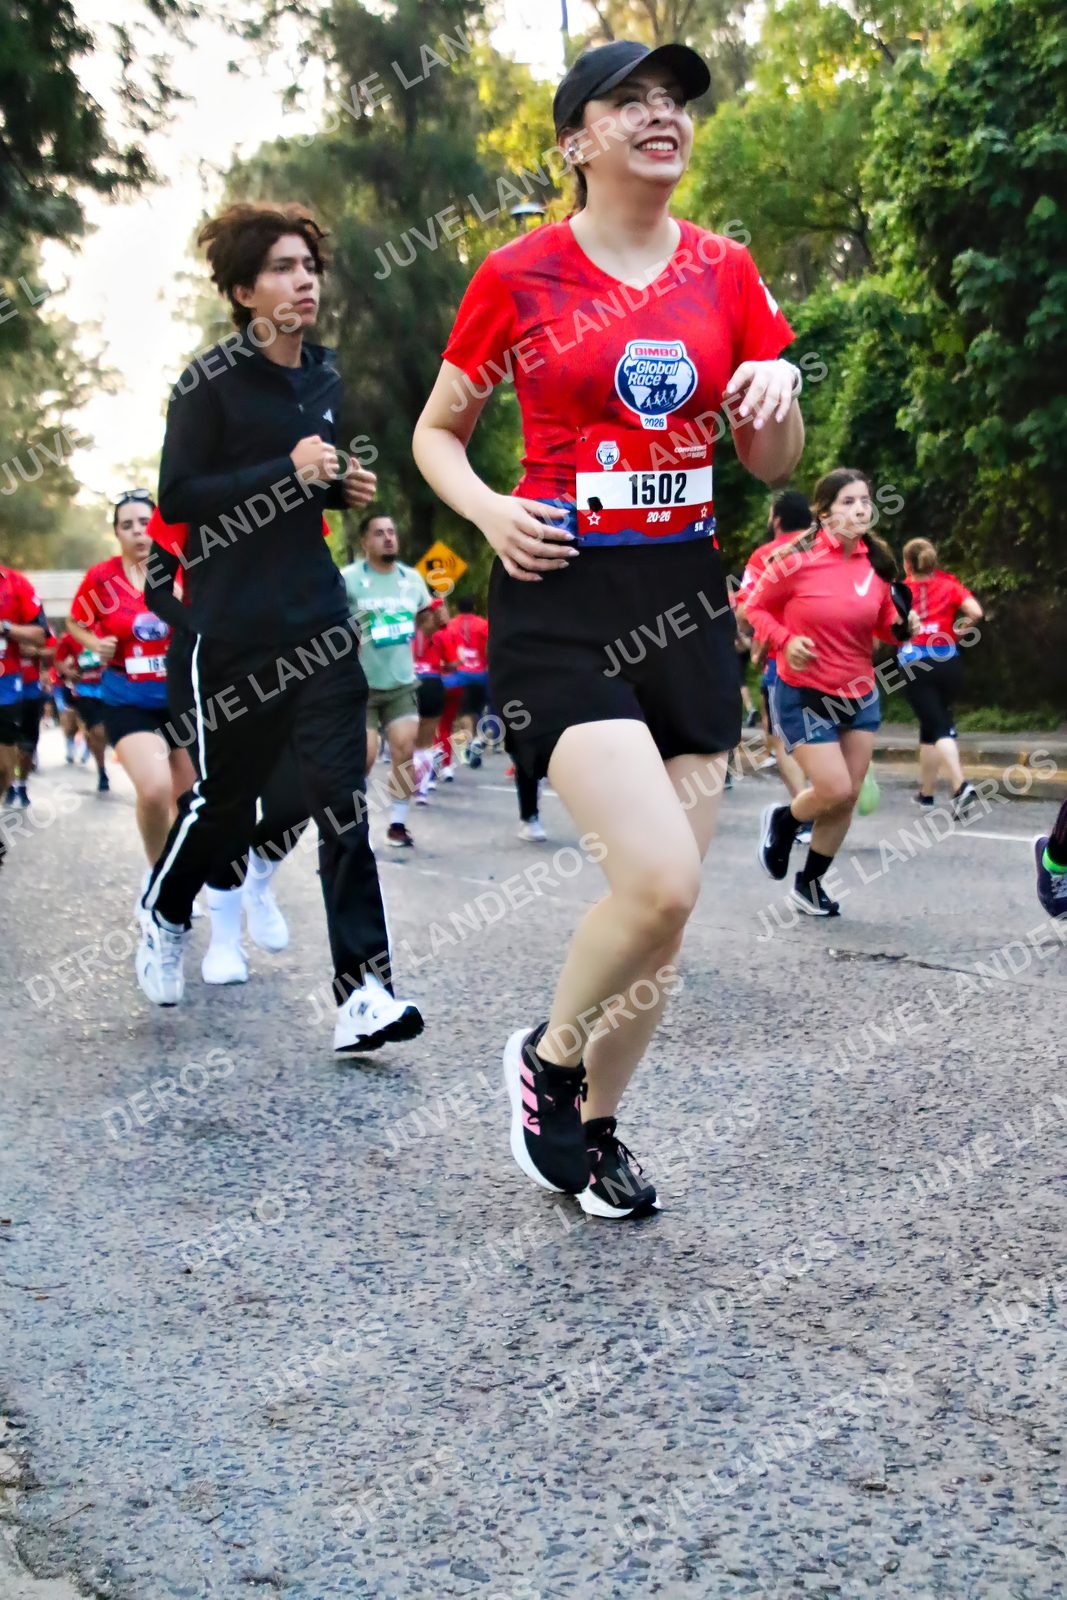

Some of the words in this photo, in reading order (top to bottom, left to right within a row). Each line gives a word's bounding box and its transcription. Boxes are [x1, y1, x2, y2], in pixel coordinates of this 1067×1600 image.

[634, 347, 678, 357] BIMBO
[636, 360, 678, 375] Global
[628, 372, 661, 386] Race
[644, 418, 664, 428] 2026
[629, 472, 687, 506] 1502
